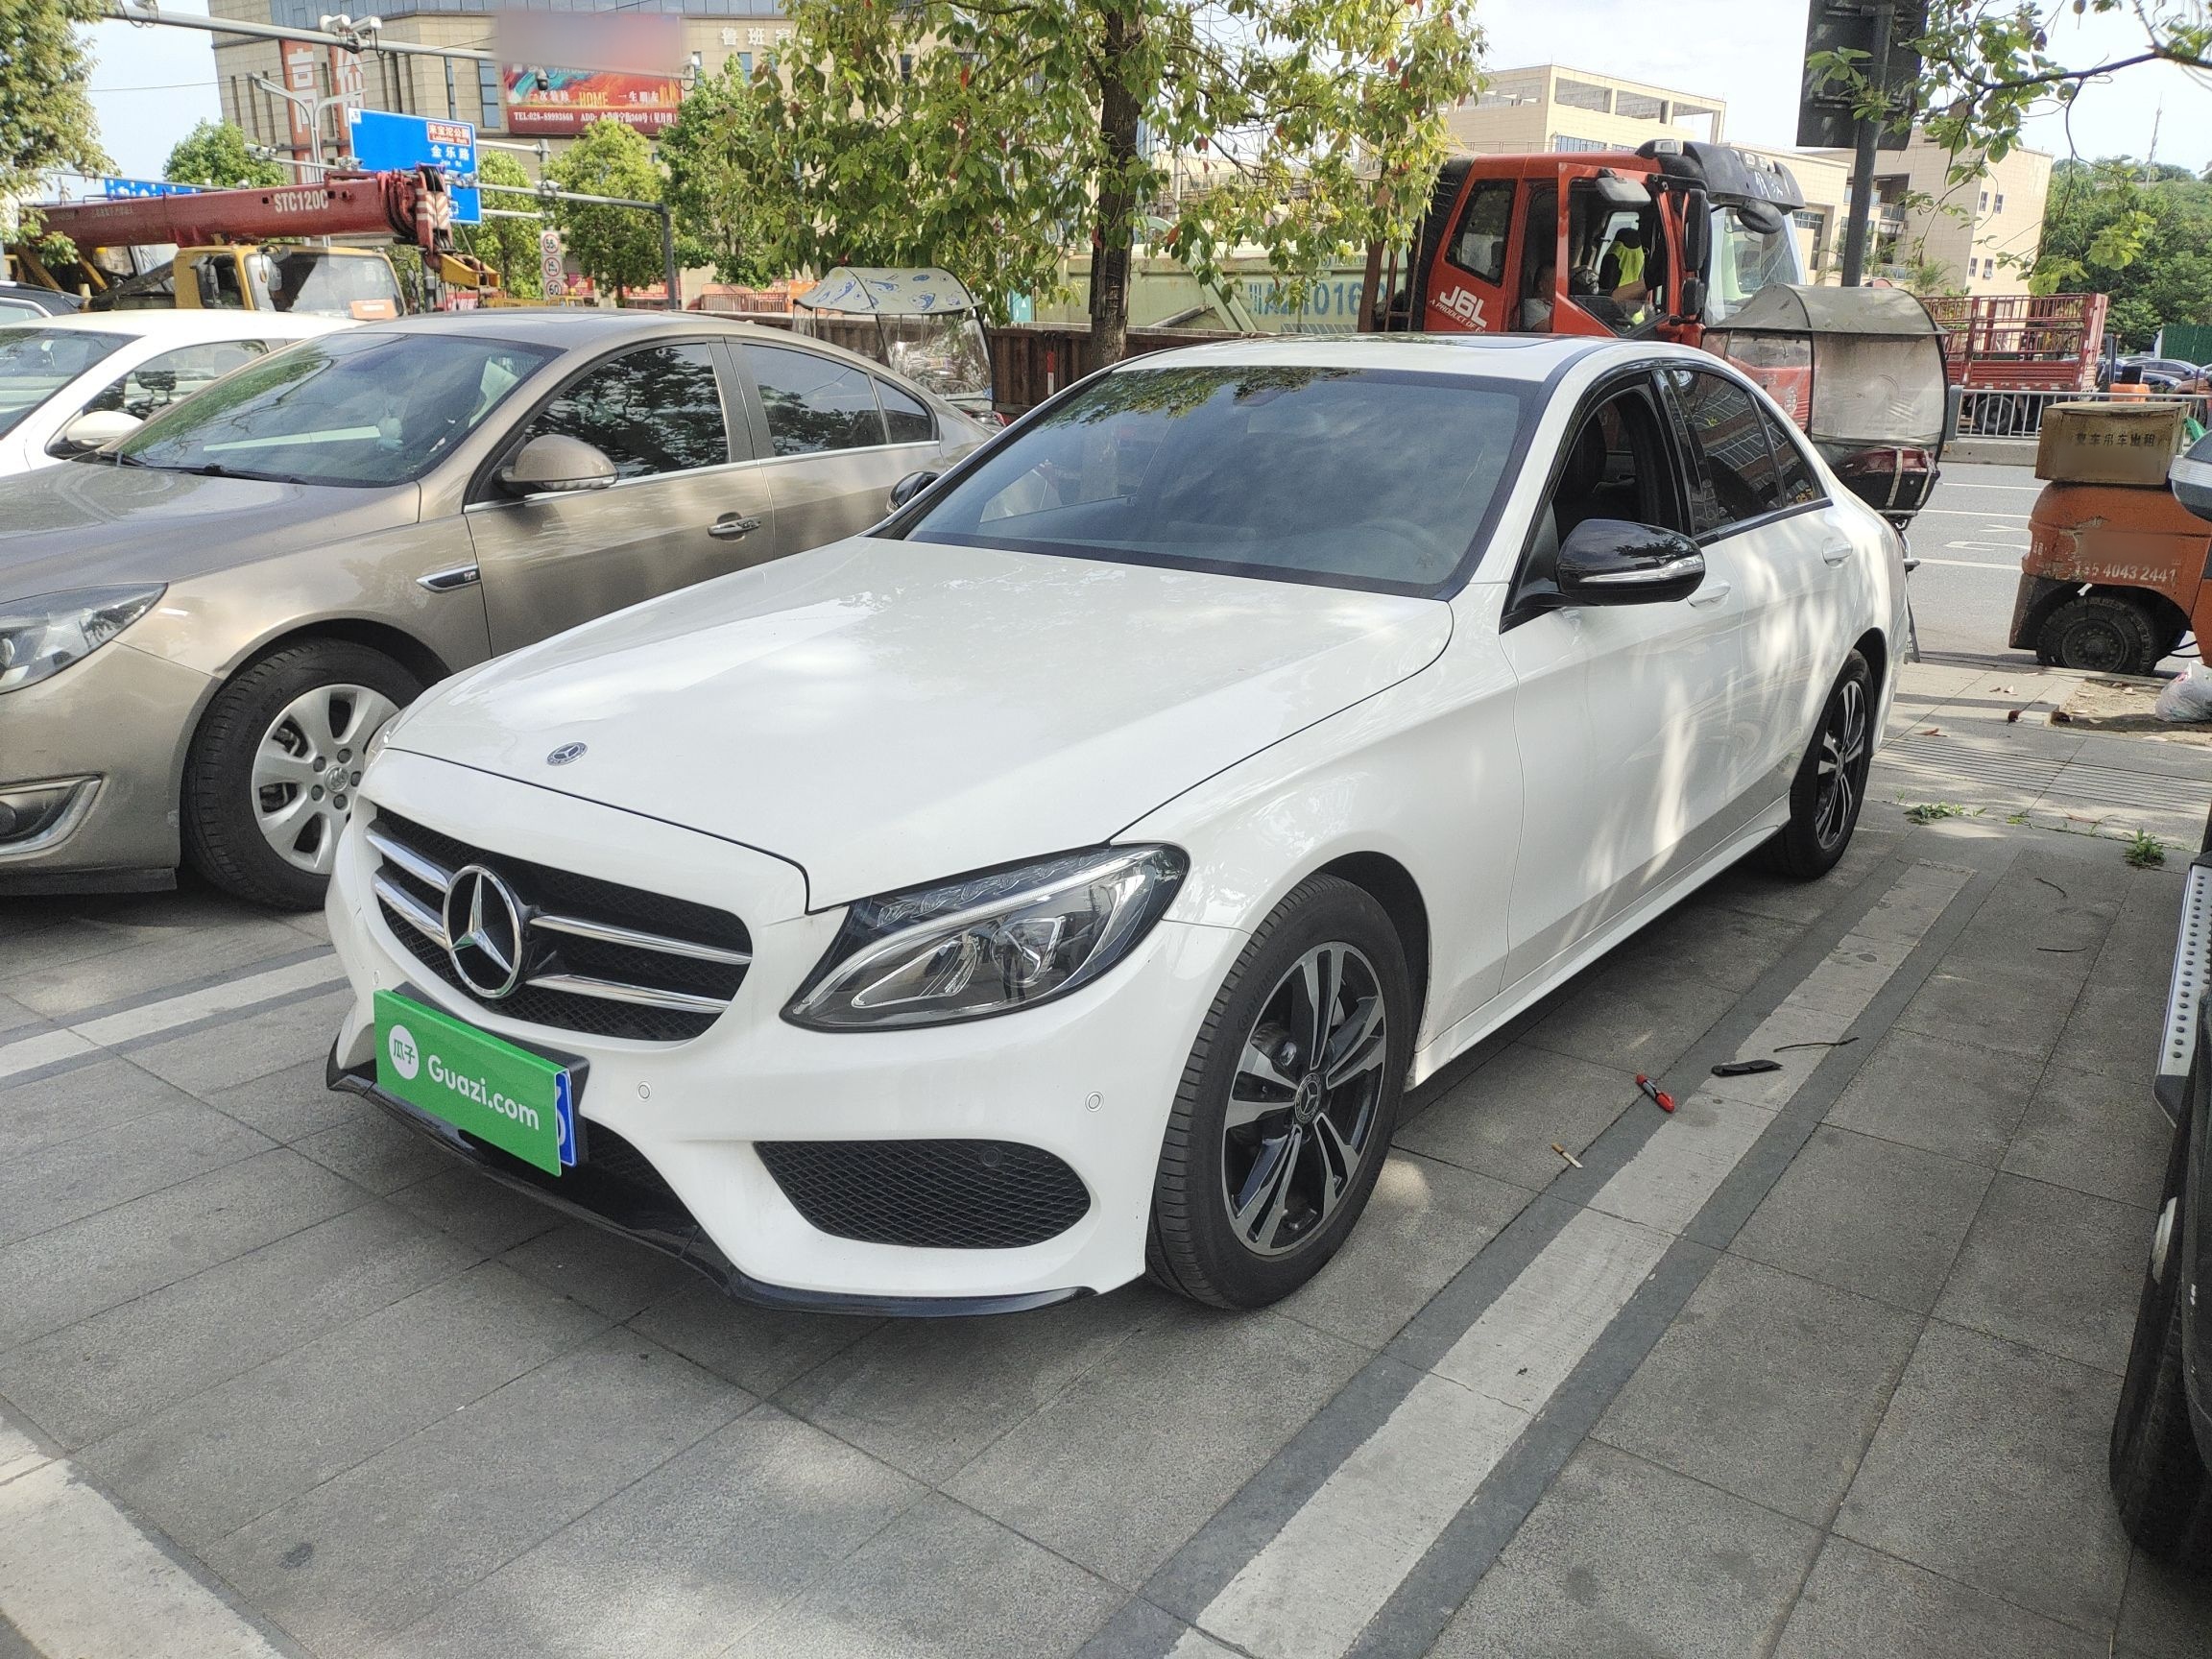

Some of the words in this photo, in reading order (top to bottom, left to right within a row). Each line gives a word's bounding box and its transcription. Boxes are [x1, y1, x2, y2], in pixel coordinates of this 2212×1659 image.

[579, 91, 609, 107] HOME
[431, 144, 469, 161] 金乐路
[274, 189, 329, 213] STC120C
[549, 284, 560, 296] 60
[1435, 301, 1467, 325] PRODUCT
[1465, 319, 1478, 329] OF
[1439, 285, 1488, 328] J6L
[2103, 565, 2137, 580] 4043
[2139, 566, 2176, 583] 2441
[392, 1038, 416, 1065] 瓜子
[427, 1054, 540, 1131] Guazi.com
